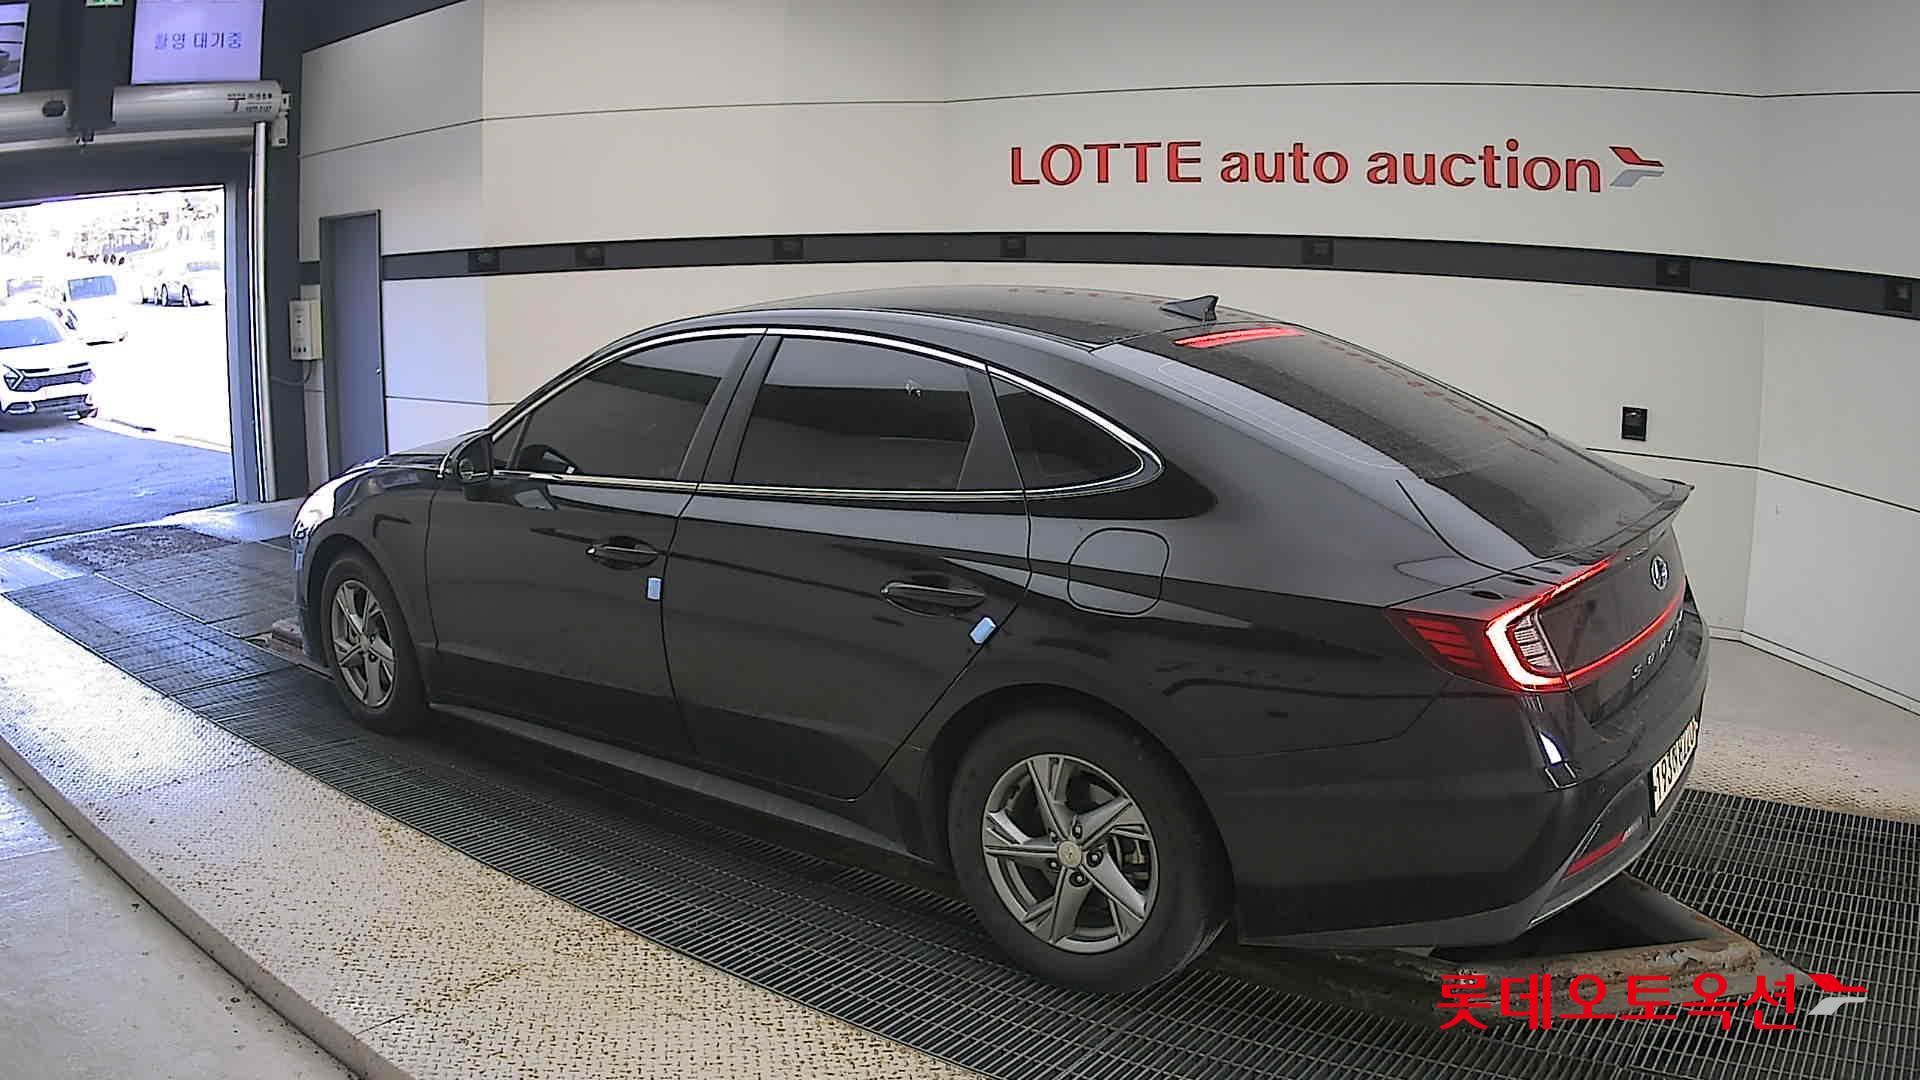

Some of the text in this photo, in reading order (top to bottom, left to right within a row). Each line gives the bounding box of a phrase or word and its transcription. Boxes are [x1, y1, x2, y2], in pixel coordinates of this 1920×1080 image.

[193, 32, 242, 48] 대기중
[1010, 138, 1601, 193] LOTTE auto auction
